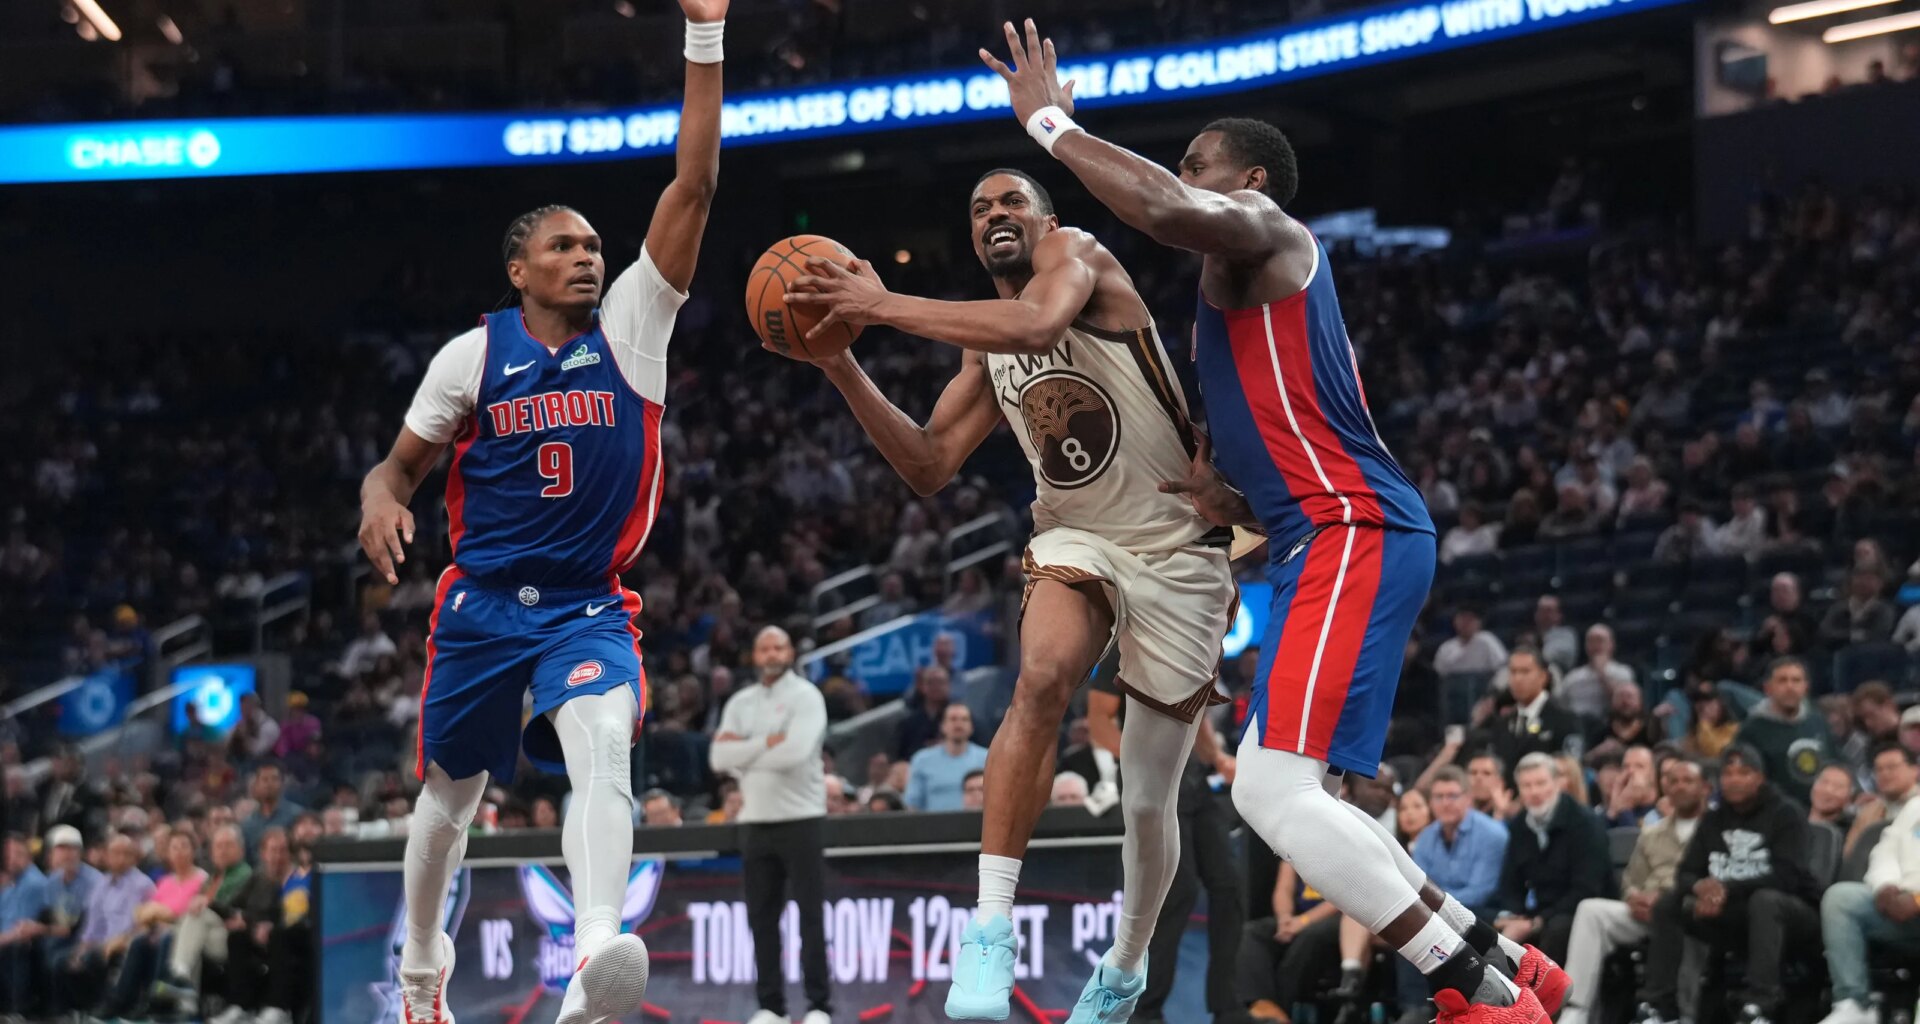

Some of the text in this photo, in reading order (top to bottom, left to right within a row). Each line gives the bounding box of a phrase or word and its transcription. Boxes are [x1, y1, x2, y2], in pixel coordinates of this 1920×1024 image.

[504, 121, 566, 155] GET
[568, 117, 624, 153] $20
[625, 110, 679, 147] OFF
[722, 90, 847, 137] RCHASES
[848, 86, 890, 122] OF
[892, 79, 964, 118] $100
[1110, 59, 1153, 95] AT
[1154, 39, 1277, 90] GOLDEN
[1279, 21, 1359, 71] STATE
[1360, 5, 1439, 54] SHOP
[1441, 0, 1523, 38] WITH
[70, 136, 183, 168] CHASE
[487, 390, 615, 437] DETROIT
[537, 441, 574, 498] 9
[1061, 437, 1091, 472] 8
[479, 918, 513, 980] VS
[687, 897, 894, 984] TOMROW
[1072, 890, 1124, 952] pri
